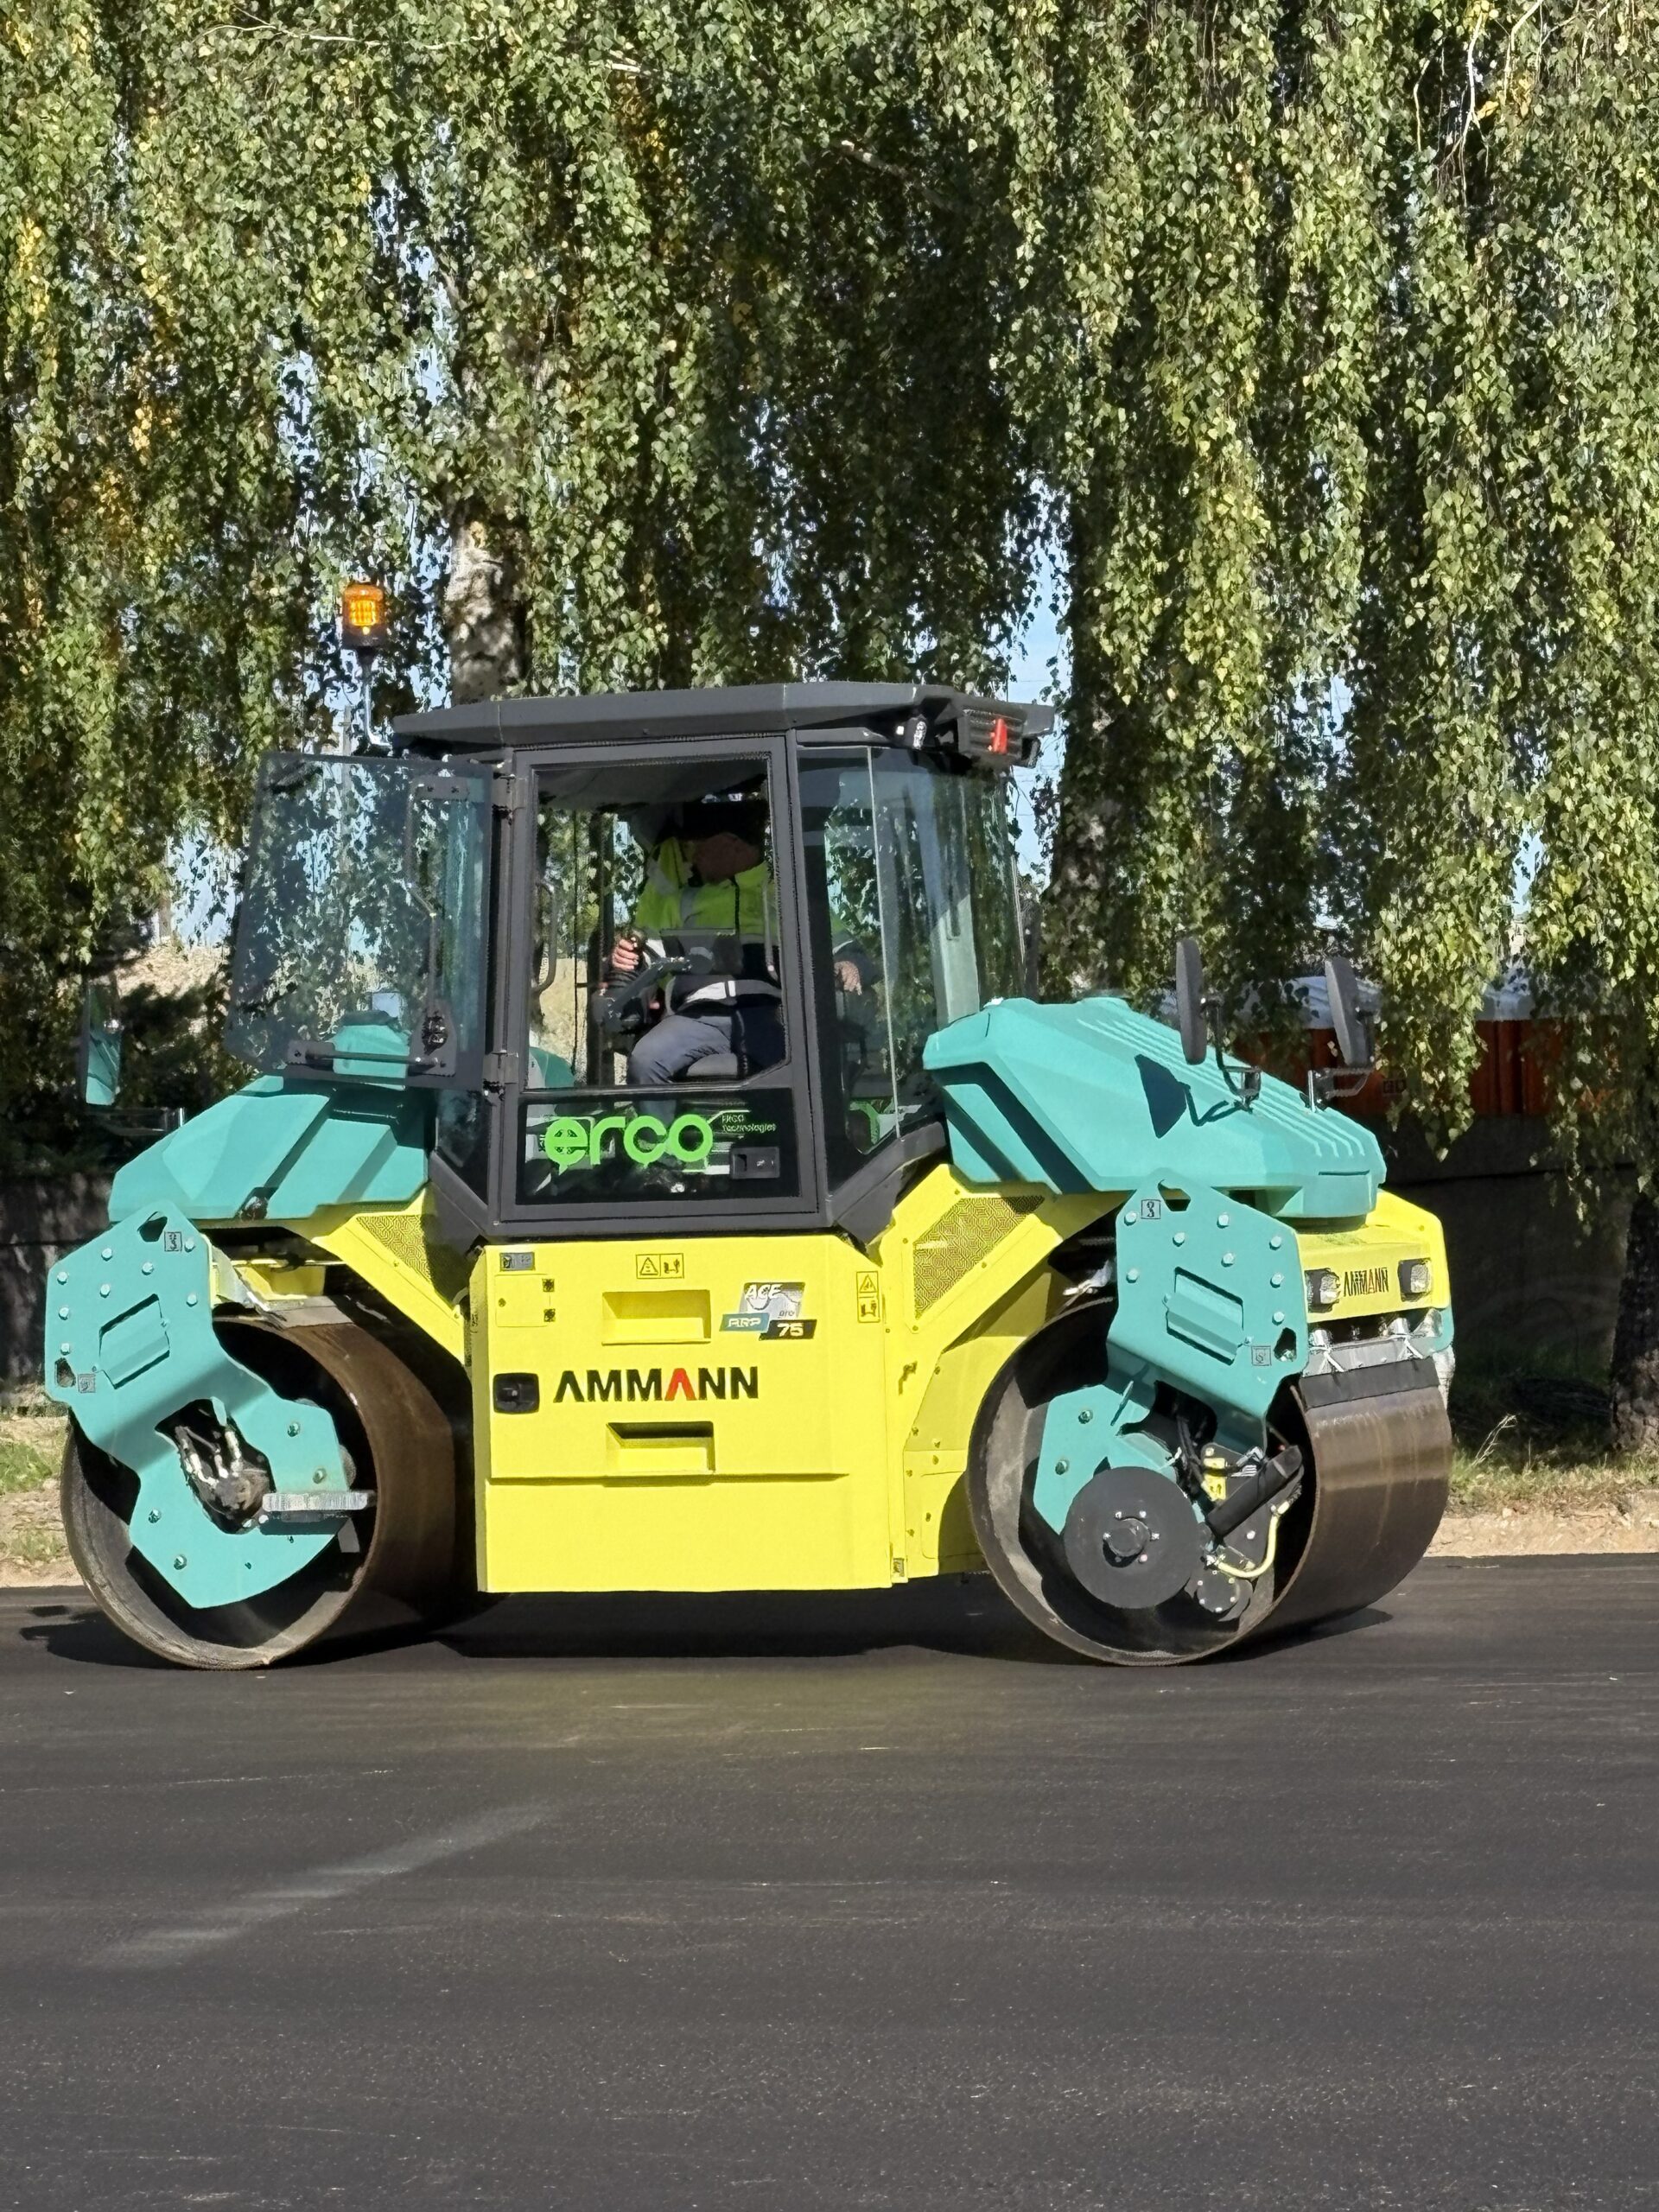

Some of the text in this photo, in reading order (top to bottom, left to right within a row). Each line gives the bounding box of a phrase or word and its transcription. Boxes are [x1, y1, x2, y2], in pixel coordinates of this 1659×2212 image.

[544, 1114, 714, 1175] erco
[744, 1284, 783, 1300] ACE
[777, 1322, 804, 1338] 75
[552, 1366, 759, 1403] AMMANN
